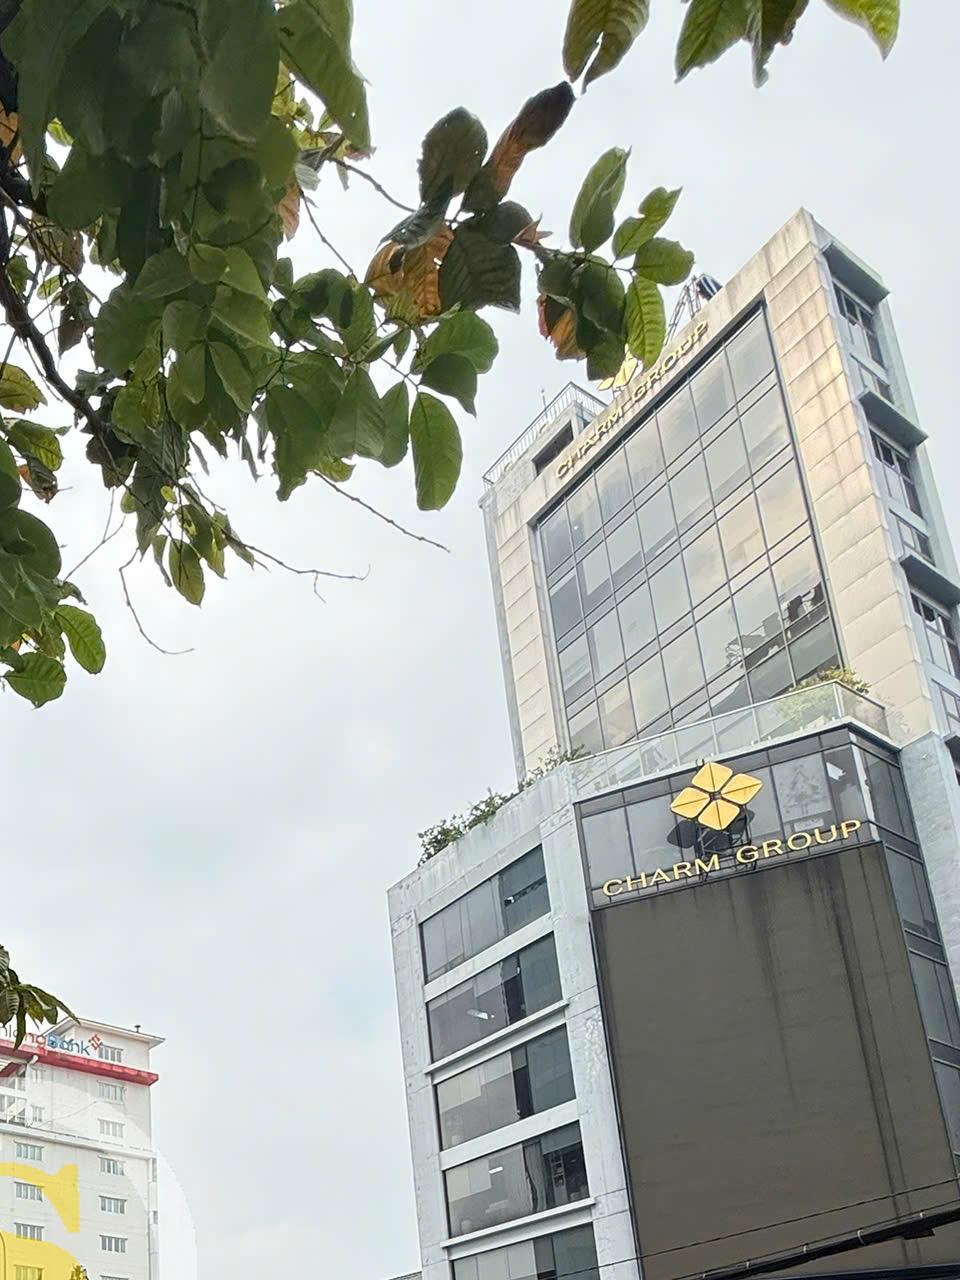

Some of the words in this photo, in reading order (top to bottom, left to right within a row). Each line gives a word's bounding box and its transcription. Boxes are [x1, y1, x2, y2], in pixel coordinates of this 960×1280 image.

[554, 404, 627, 479] CHARM
[632, 319, 710, 403] GROUP
[602, 854, 722, 898] CHARM
[735, 819, 862, 865] GROUP
